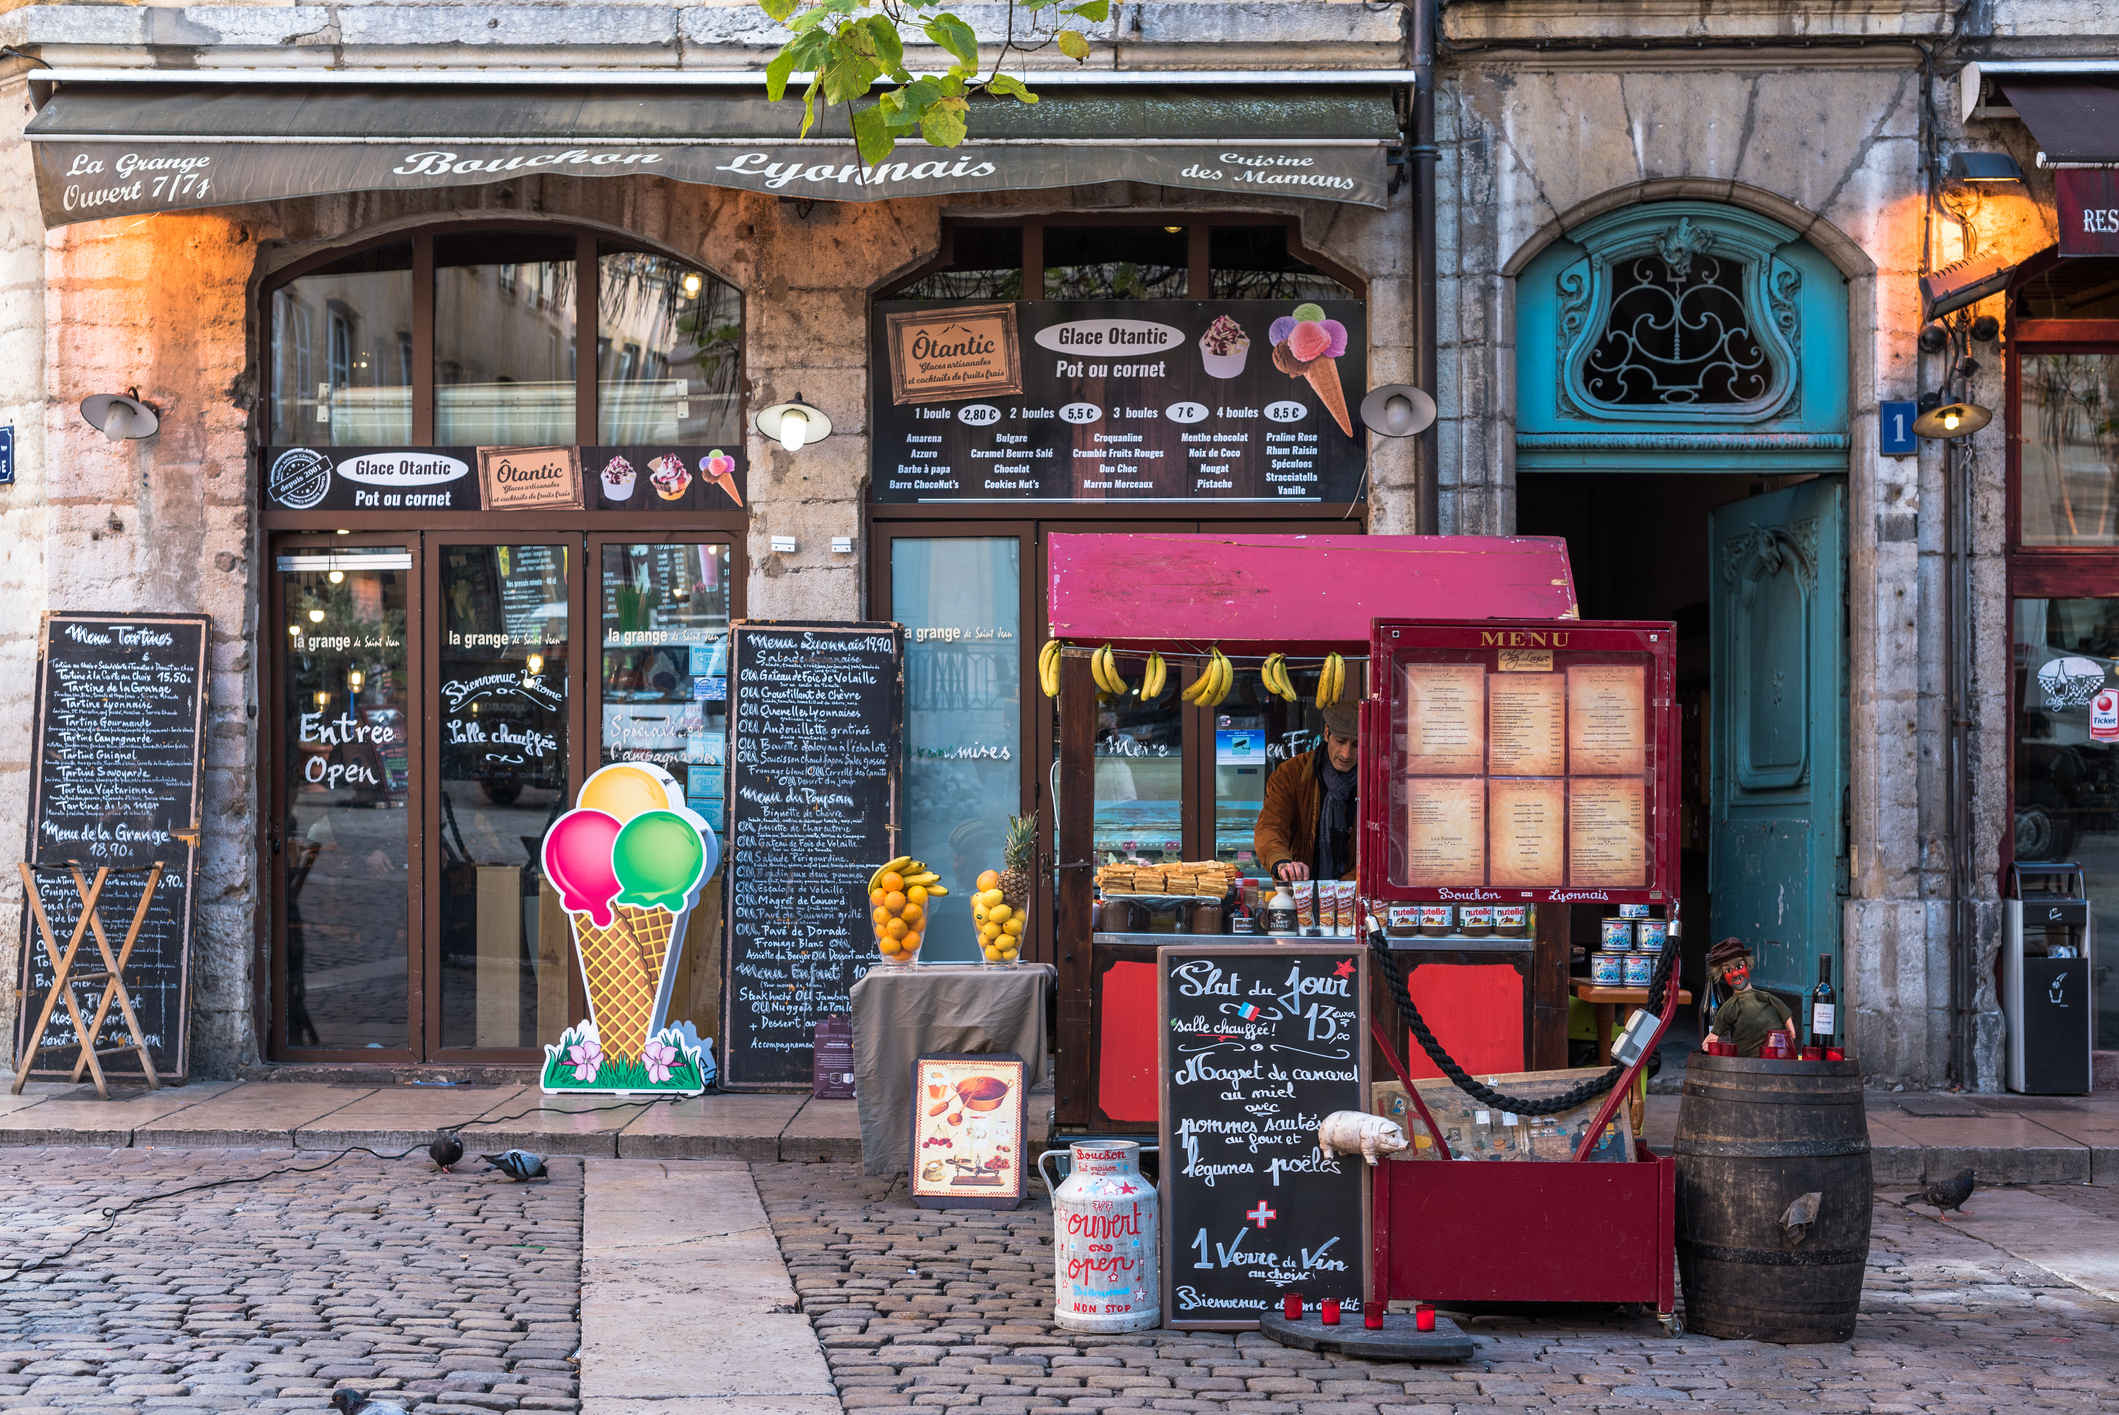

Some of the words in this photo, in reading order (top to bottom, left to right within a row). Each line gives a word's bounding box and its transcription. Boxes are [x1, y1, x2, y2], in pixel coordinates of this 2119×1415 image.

[66, 154, 104, 176] La
[116, 154, 210, 179] Grange
[393, 150, 663, 176] Bouchon
[1220, 153, 1314, 166] Cuisine
[716, 152, 996, 188] Lyonnais
[1181, 164, 1222, 180] des
[1234, 170, 1354, 189] Mamans
[63, 180, 142, 210] Ouvert
[152, 173, 210, 202] 7/7j
[2084, 209, 2119, 233] RES
[1059, 328, 1102, 344] Glace
[1109, 328, 1167, 344] Otantic
[912, 328, 995, 360] Ôtantic
[919, 362, 946, 374] Glaces
[947, 357, 991, 368] artisanales
[1056, 360, 1084, 377] Pot
[1089, 365, 1108, 377] ou
[1113, 361, 1165, 377] cornet
[916, 373, 950, 384] cocktails
[952, 372, 961, 380] de
[963, 371, 984, 382] fruits
[986, 369, 1004, 380] frais
[916, 408, 920, 418] 1
[924, 408, 950, 418] boule
[964, 410, 986, 421] 2,80
[989, 410, 996, 420] €
[1010, 408, 1016, 418] 2
[1022, 408, 1054, 418] boules
[1068, 408, 1083, 420] 5,5
[1085, 408, 1093, 420] €
[1114, 407, 1120, 418] 3
[1126, 407, 1158, 418] boules
[1178, 407, 1184, 418] 7
[1187, 407, 1194, 418] €
[1217, 407, 1223, 418] 4
[1226, 407, 1258, 418] boules
[1274, 408, 1288, 419] 8,5
[1292, 408, 1299, 418] €
[1894, 414, 1906, 442] 1
[906, 434, 942, 442] Amarena
[996, 434, 1027, 444] Bulgare
[1181, 433, 1211, 442] Menthe
[1213, 433, 1248, 442] chocolat
[1266, 432, 1295, 441] Praline
[1298, 432, 1317, 441] Rose
[911, 449, 937, 458] Azzuro
[971, 449, 1004, 458] Caramel
[1006, 449, 1034, 458] Beurre
[1036, 448, 1053, 458] Salé
[1073, 449, 1106, 457] Crumble
[1109, 449, 1132, 457] Fruits
[1134, 449, 1164, 459] Rouges
[1189, 448, 1206, 457] Noix
[1208, 448, 1218, 457] de
[1221, 448, 1240, 457] Coco
[1266, 446, 1289, 455] Rhum
[1292, 446, 1317, 454] Raisin
[356, 460, 394, 475] Glace
[400, 460, 450, 475] Otantic
[497, 459, 563, 483] Ôtantic
[898, 464, 921, 473] Barbe
[923, 464, 928, 474] à
[931, 466, 950, 475] papa
[994, 464, 1030, 473] Chocolat
[1099, 464, 1115, 473] Duo
[1117, 464, 1137, 473] Choc
[1200, 464, 1229, 474] Nougat
[1272, 459, 1312, 470] Spéculoos
[279, 475, 305, 493] depuis
[303, 463, 323, 479] 2001
[1197, 479, 1232, 488] Pistache
[1266, 472, 1317, 481] Stracciatella
[502, 485, 524, 494] Glaces
[525, 481, 559, 490] artisanales
[890, 480, 911, 488] Barre
[914, 480, 959, 488] ChocoNut's
[985, 480, 1016, 488] Cookies
[1019, 480, 1039, 488] Nut's
[1084, 480, 1112, 488] Marron
[1115, 480, 1153, 488] Morceaux
[1278, 486, 1305, 494] Vanille
[356, 490, 380, 506] Pot
[384, 494, 400, 506] ou
[405, 492, 451, 506] cornet
[65, 624, 112, 645] Menu
[108, 626, 173, 646] Tartines
[450, 630, 460, 645] la
[465, 634, 510, 648] grange
[511, 636, 520, 644] de
[524, 634, 542, 645] Saint
[545, 634, 561, 644] Jean
[747, 633, 798, 649] Menu
[916, 627, 961, 642] grange
[1481, 632, 1570, 646] MENU
[756, 651, 805, 664] Salade
[1499, 649, 1525, 669] Chez
[1523, 650, 1551, 663] Louise
[441, 673, 522, 706] Bienvenue,
[761, 686, 815, 699] Croustillant
[828, 688, 861, 700] Chèvre
[61, 698, 100, 708] Tartine
[102, 698, 153, 714] Lyonnaise
[58, 715, 98, 727] Tartine
[100, 716, 151, 729] Gourmande
[300, 710, 397, 745] Entrée
[58, 732, 92, 743] Tartine
[94, 733, 152, 744] Campagnarde
[447, 720, 488, 744] Salle
[492, 724, 557, 757] chauffée
[96, 750, 137, 763] Guignol
[97, 767, 150, 780] Savoyarde
[305, 756, 379, 790] Open
[95, 785, 154, 798] Végétarienne
[1438, 887, 1502, 900] Bouchon
[1548, 888, 1609, 902] Lyonnais
[1393, 908, 1419, 917] nutella
[1466, 908, 1491, 917] nutella
[1497, 908, 1524, 916] nutella
[763, 925, 787, 936] Pavé
[754, 937, 795, 951] Fromage
[799, 938, 823, 948] Blanc
[1248, 980, 1276, 995] du
[1276, 959, 1352, 1017] jour
[772, 1002, 812, 1015] Nuggets
[1172, 1015, 1211, 1033] salle
[1175, 1052, 1264, 1090] Magret
[1268, 1064, 1288, 1080] de
[1292, 1064, 1358, 1082] canard
[1174, 1118, 1258, 1150] pommes
[1076, 1149, 1126, 1160] Bouchon
[1180, 1134, 1255, 1187] légumes
[1068, 1201, 1142, 1239] ouvert
[1191, 1228, 1214, 1269] 1
[1216, 1227, 1280, 1268] Verre
[1282, 1256, 1297, 1268] de
[1301, 1236, 1348, 1271] Vin
[1068, 1256, 1134, 1286] open
[1176, 1286, 1268, 1310] Bienvenue
[1074, 1302, 1096, 1313] NON
[1105, 1305, 1130, 1313] STOP
